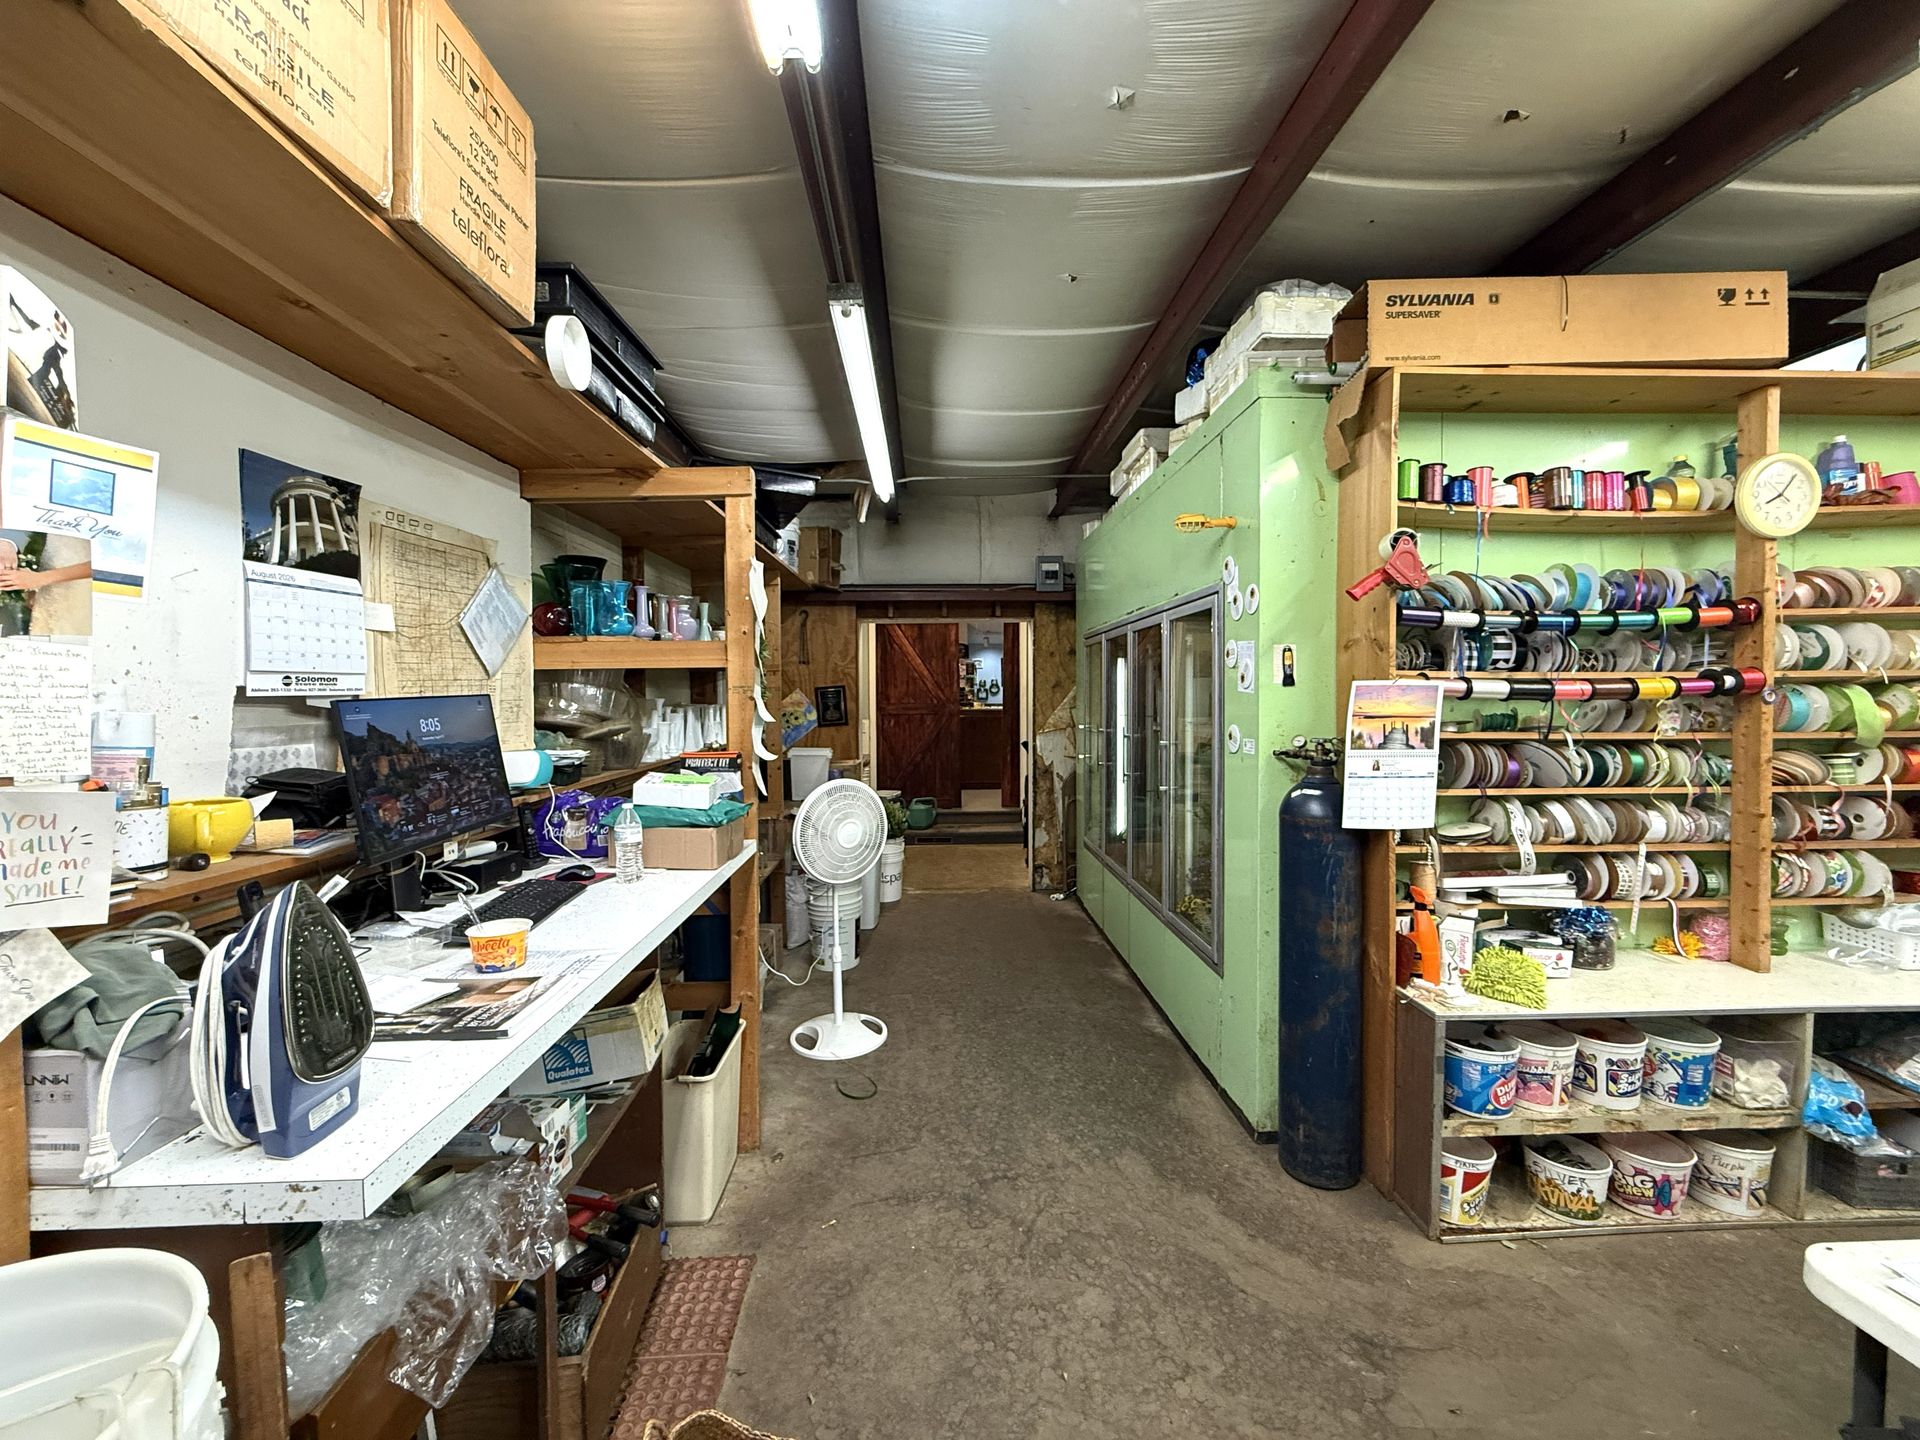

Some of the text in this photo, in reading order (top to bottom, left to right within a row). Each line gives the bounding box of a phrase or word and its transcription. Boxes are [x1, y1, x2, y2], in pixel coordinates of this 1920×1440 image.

[282, 0, 310, 31] ack
[326, 69, 356, 103] Gazebo
[469, 142, 479, 162] 12
[480, 156, 499, 185] Pack
[459, 176, 507, 236] FRAGILE
[1385, 293, 1475, 307] SYLVANIA
[1385, 353, 1441, 363] www.sylvania.com
[33, 505, 124, 540] Thank You
[251, 569, 278, 581] August
[419, 717, 441, 733] 8:05
[1, 811, 57, 834] YOU
[57, 856, 91, 871] me
[4, 875, 84, 903] SMILE!
[547, 1065, 591, 1081] Qualatex
[1532, 1160, 1591, 1188] SILVER
[1612, 1168, 1656, 1189] BIG
